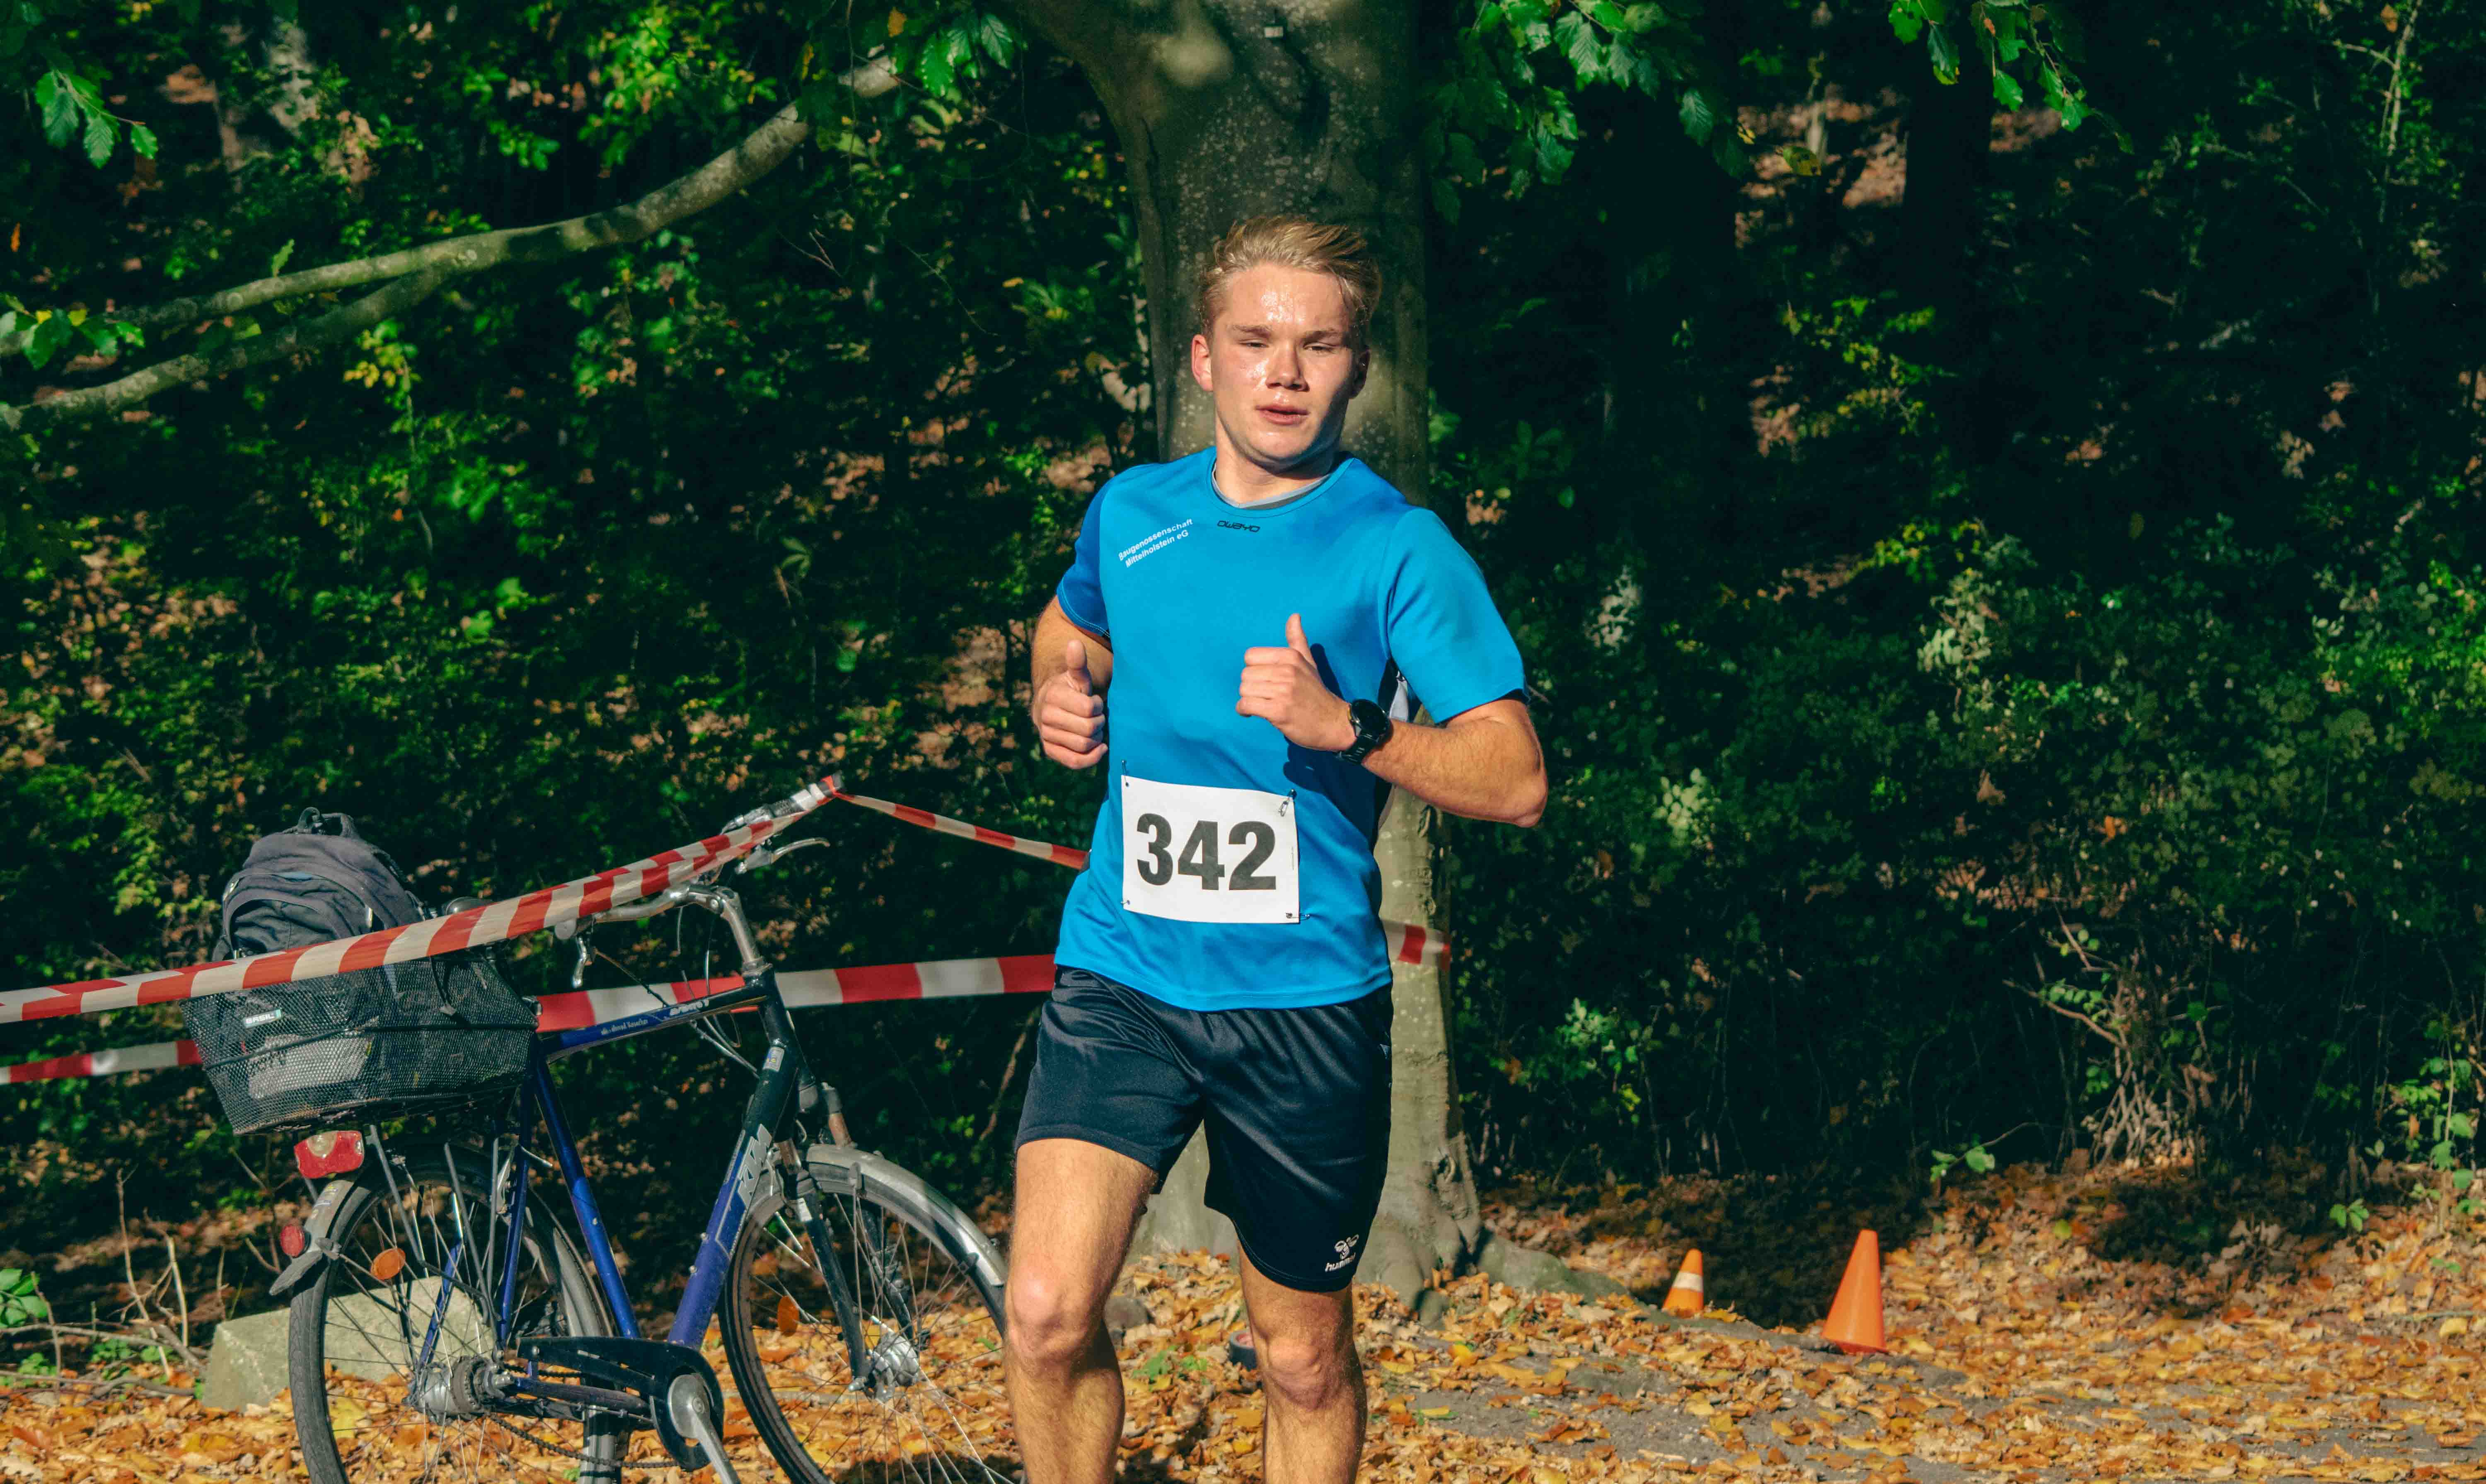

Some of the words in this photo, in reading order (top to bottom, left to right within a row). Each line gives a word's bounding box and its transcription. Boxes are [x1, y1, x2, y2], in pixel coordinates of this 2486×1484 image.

[1118, 518, 1193, 561] Baugenossenschaft
[1125, 537, 1175, 568] Mittelholstein
[1176, 529, 1188, 539] eG
[1137, 813, 1276, 890] 342
